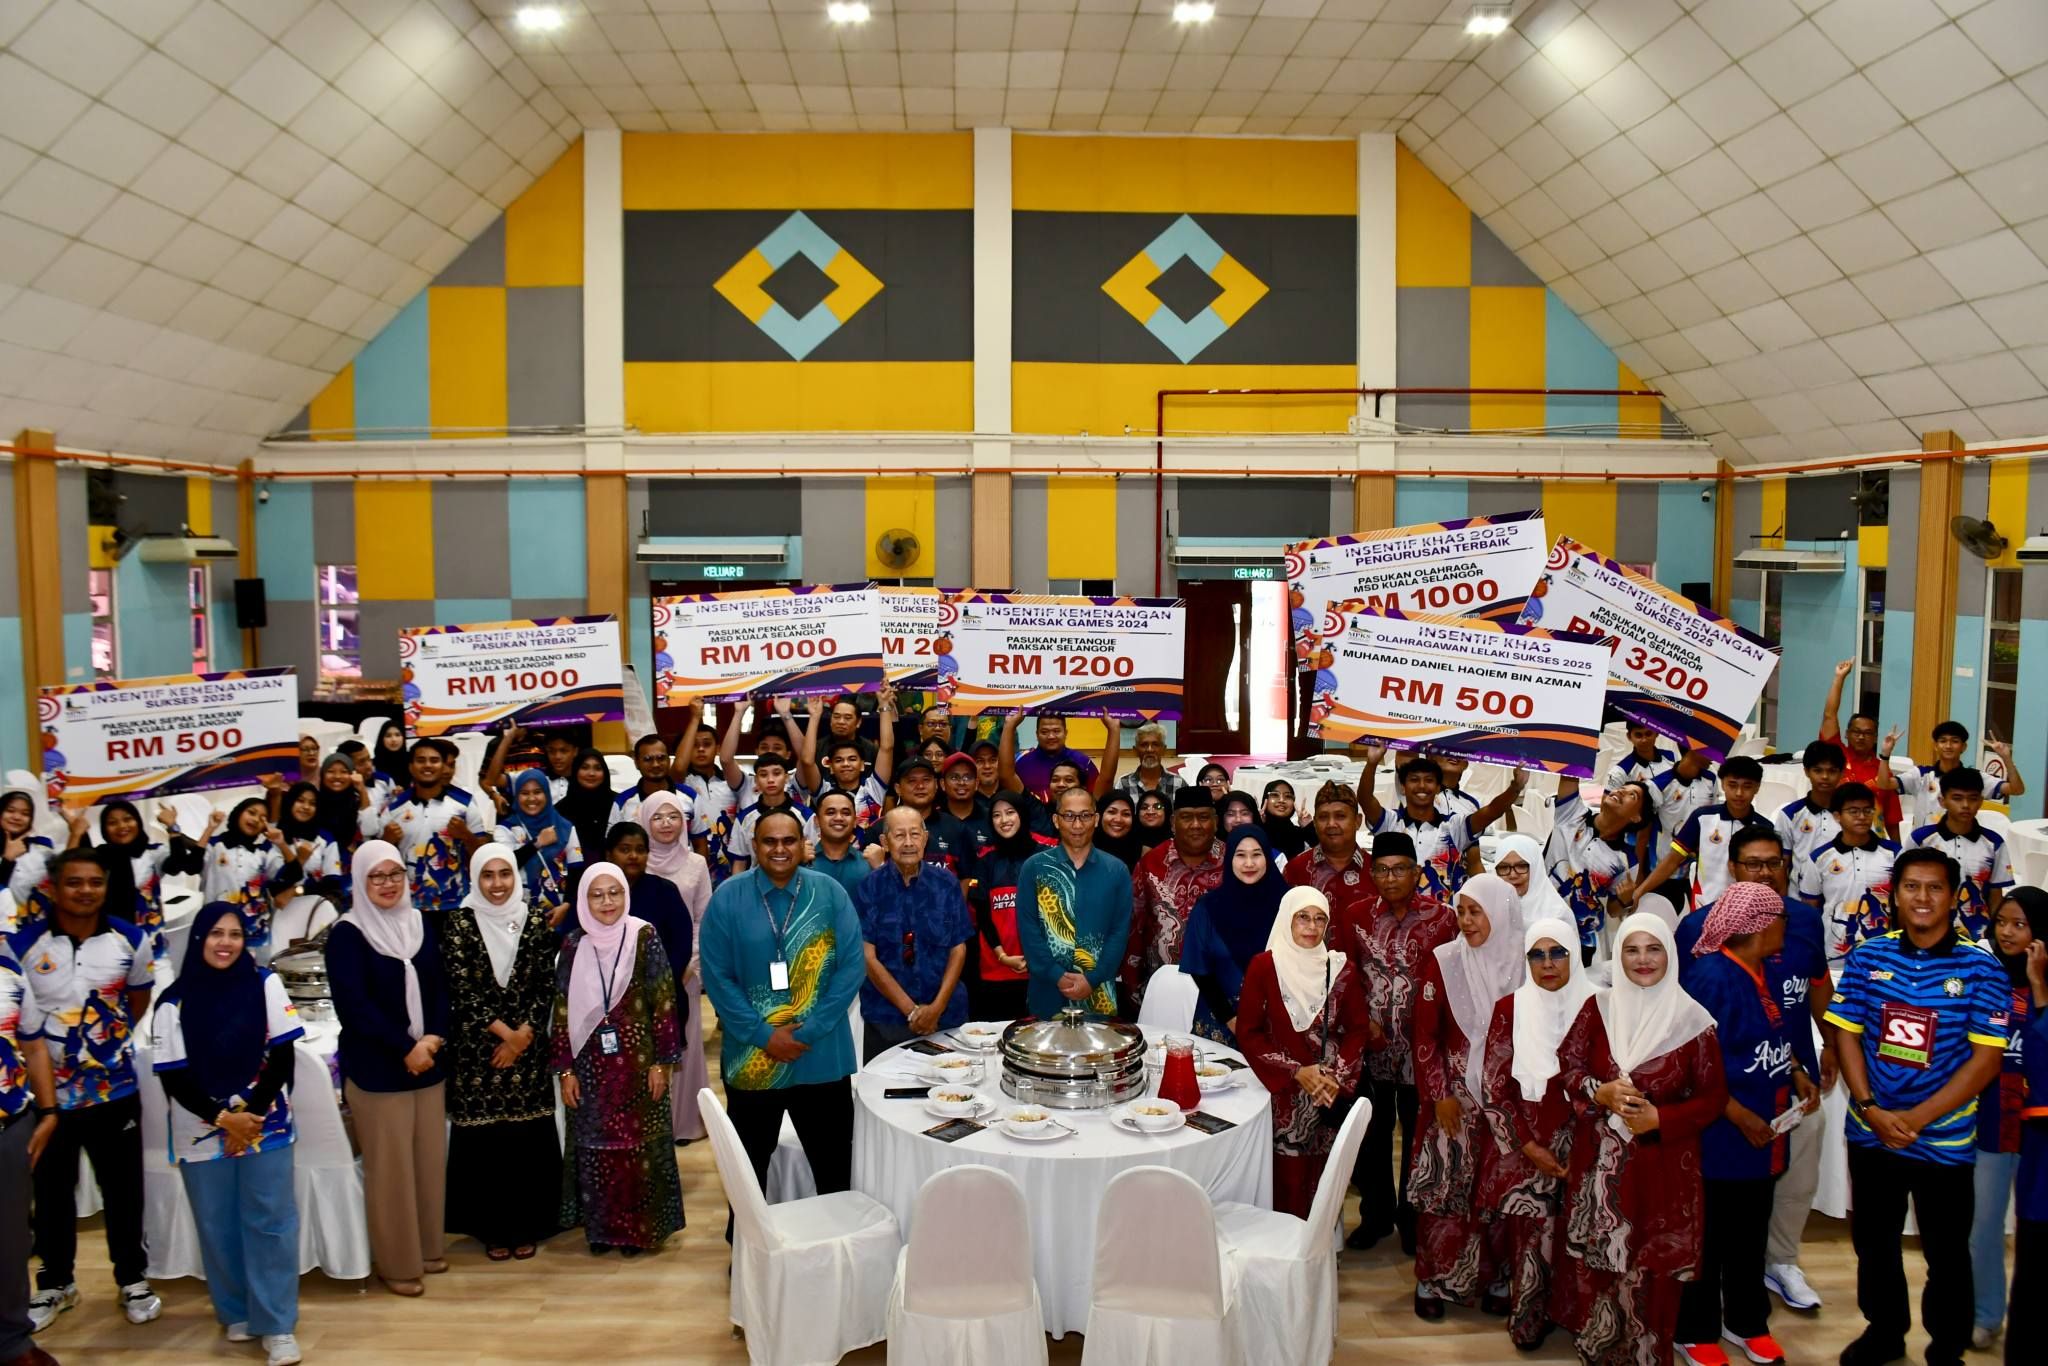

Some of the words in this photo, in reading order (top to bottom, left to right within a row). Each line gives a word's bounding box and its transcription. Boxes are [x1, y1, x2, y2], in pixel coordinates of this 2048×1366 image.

[1345, 539, 1418, 558] INSENTIF
[1422, 533, 1465, 548] KHAS
[1469, 526, 1518, 541] 2025
[1355, 546, 1450, 566] PENGURUSAN
[1454, 538, 1511, 552] TERBAIK
[704, 566, 736, 577] KELUAR
[1234, 568, 1266, 578] KELUAR
[1353, 582, 1380, 593] MSD
[1382, 577, 1420, 589] KUALA
[1422, 568, 1484, 583] SELANGOR
[1358, 571, 1412, 585] PASUKAN
[1414, 562, 1478, 578] OLAHRAGA
[696, 600, 758, 614] INSENTIF
[763, 593, 866, 609] KEMENANGAN
[1410, 579, 1499, 610] 1000
[742, 608, 790, 618] SUKSES
[792, 606, 821, 615] 2025
[986, 607, 1054, 617] INSENTIF
[1059, 608, 1171, 620] KEMENANGAN
[1009, 617, 1065, 627] MAKSAK
[1067, 618, 1115, 628] GAMES
[1117, 619, 1148, 629] 2024
[1594, 568, 1659, 606] INSENTIF
[1661, 601, 1764, 662] KEMENANGAN
[451, 632, 512, 644] INSENTIF
[517, 628, 553, 640] KHAS
[555, 626, 597, 637] 2025
[708, 628, 755, 637] PASUKAN
[757, 625, 798, 634] PENCAK
[800, 622, 826, 631] SILAT
[711, 635, 733, 643] MSD
[736, 632, 767, 641] KUALA
[770, 629, 825, 639] SELANGOR
[1598, 606, 1646, 636] PASUKAN
[1649, 631, 1702, 663] OLAHRAGA
[1634, 602, 1683, 631] SUKSES
[1685, 625, 1715, 648] 2025
[472, 640, 529, 650] PASUKAN
[531, 636, 577, 647] TERBAIK
[700, 644, 751, 665] RM
[760, 638, 837, 660] 1000
[882, 637, 905, 655] M
[1006, 636, 1058, 645] PASUKAN
[1060, 637, 1117, 646] PETANQUE
[1008, 643, 1053, 651] MAKSAK
[1056, 644, 1115, 653] SELANGOR
[1419, 626, 1499, 646] INSENTIF
[1504, 637, 1552, 654] KHAS
[1590, 611, 1613, 627] MSD
[1614, 623, 1648, 645] KUALA
[1649, 641, 1704, 672] SELANGOR
[436, 659, 482, 668] PASUKAN
[484, 657, 520, 666] BOLING
[523, 654, 562, 663] PADANG
[564, 652, 586, 660] MSD
[1376, 634, 1468, 654] OLAHRAGAWAN
[1471, 646, 1510, 659] LELAKI
[1512, 651, 1560, 666] SUKSES
[1562, 658, 1592, 670] 2025
[468, 664, 500, 672] KUALA
[503, 661, 555, 670] SELANGOR
[988, 654, 1042, 675] RM
[1052, 655, 1134, 677] 1200
[1343, 649, 1408, 666] MUHAMAD
[1411, 657, 1455, 672] DANIEL
[1457, 664, 1508, 680] HAQIEM
[1511, 671, 1533, 683] BIN
[1535, 675, 1582, 690] AZMAN
[1625, 646, 1709, 701] 3200
[91, 689, 164, 705] INSENTIF
[170, 679, 284, 698] KEMENANGAN
[447, 675, 496, 696] RM
[505, 668, 579, 691] 1000
[1623, 678, 1638, 688] TIGA
[145, 697, 199, 709] SUKSES
[203, 693, 235, 704] 2025
[1379, 675, 1444, 707] RM
[1455, 687, 1535, 719] 500
[102, 718, 157, 730] PASUKAN
[159, 714, 195, 725] SEPAK
[198, 710, 244, 721] TAKRAW
[109, 727, 136, 737] MSD
[138, 724, 176, 735] KUALA
[177, 718, 238, 730] SELANGOR
[1388, 711, 1423, 722] RINGGIT
[1424, 717, 1466, 728] MALAYSIA
[1468, 723, 1490, 731] LIMA
[1491, 726, 1519, 736] RATUS
[106, 736, 164, 761] RM
[176, 728, 243, 753] 500
[1885, 1019, 1925, 1047] SS
